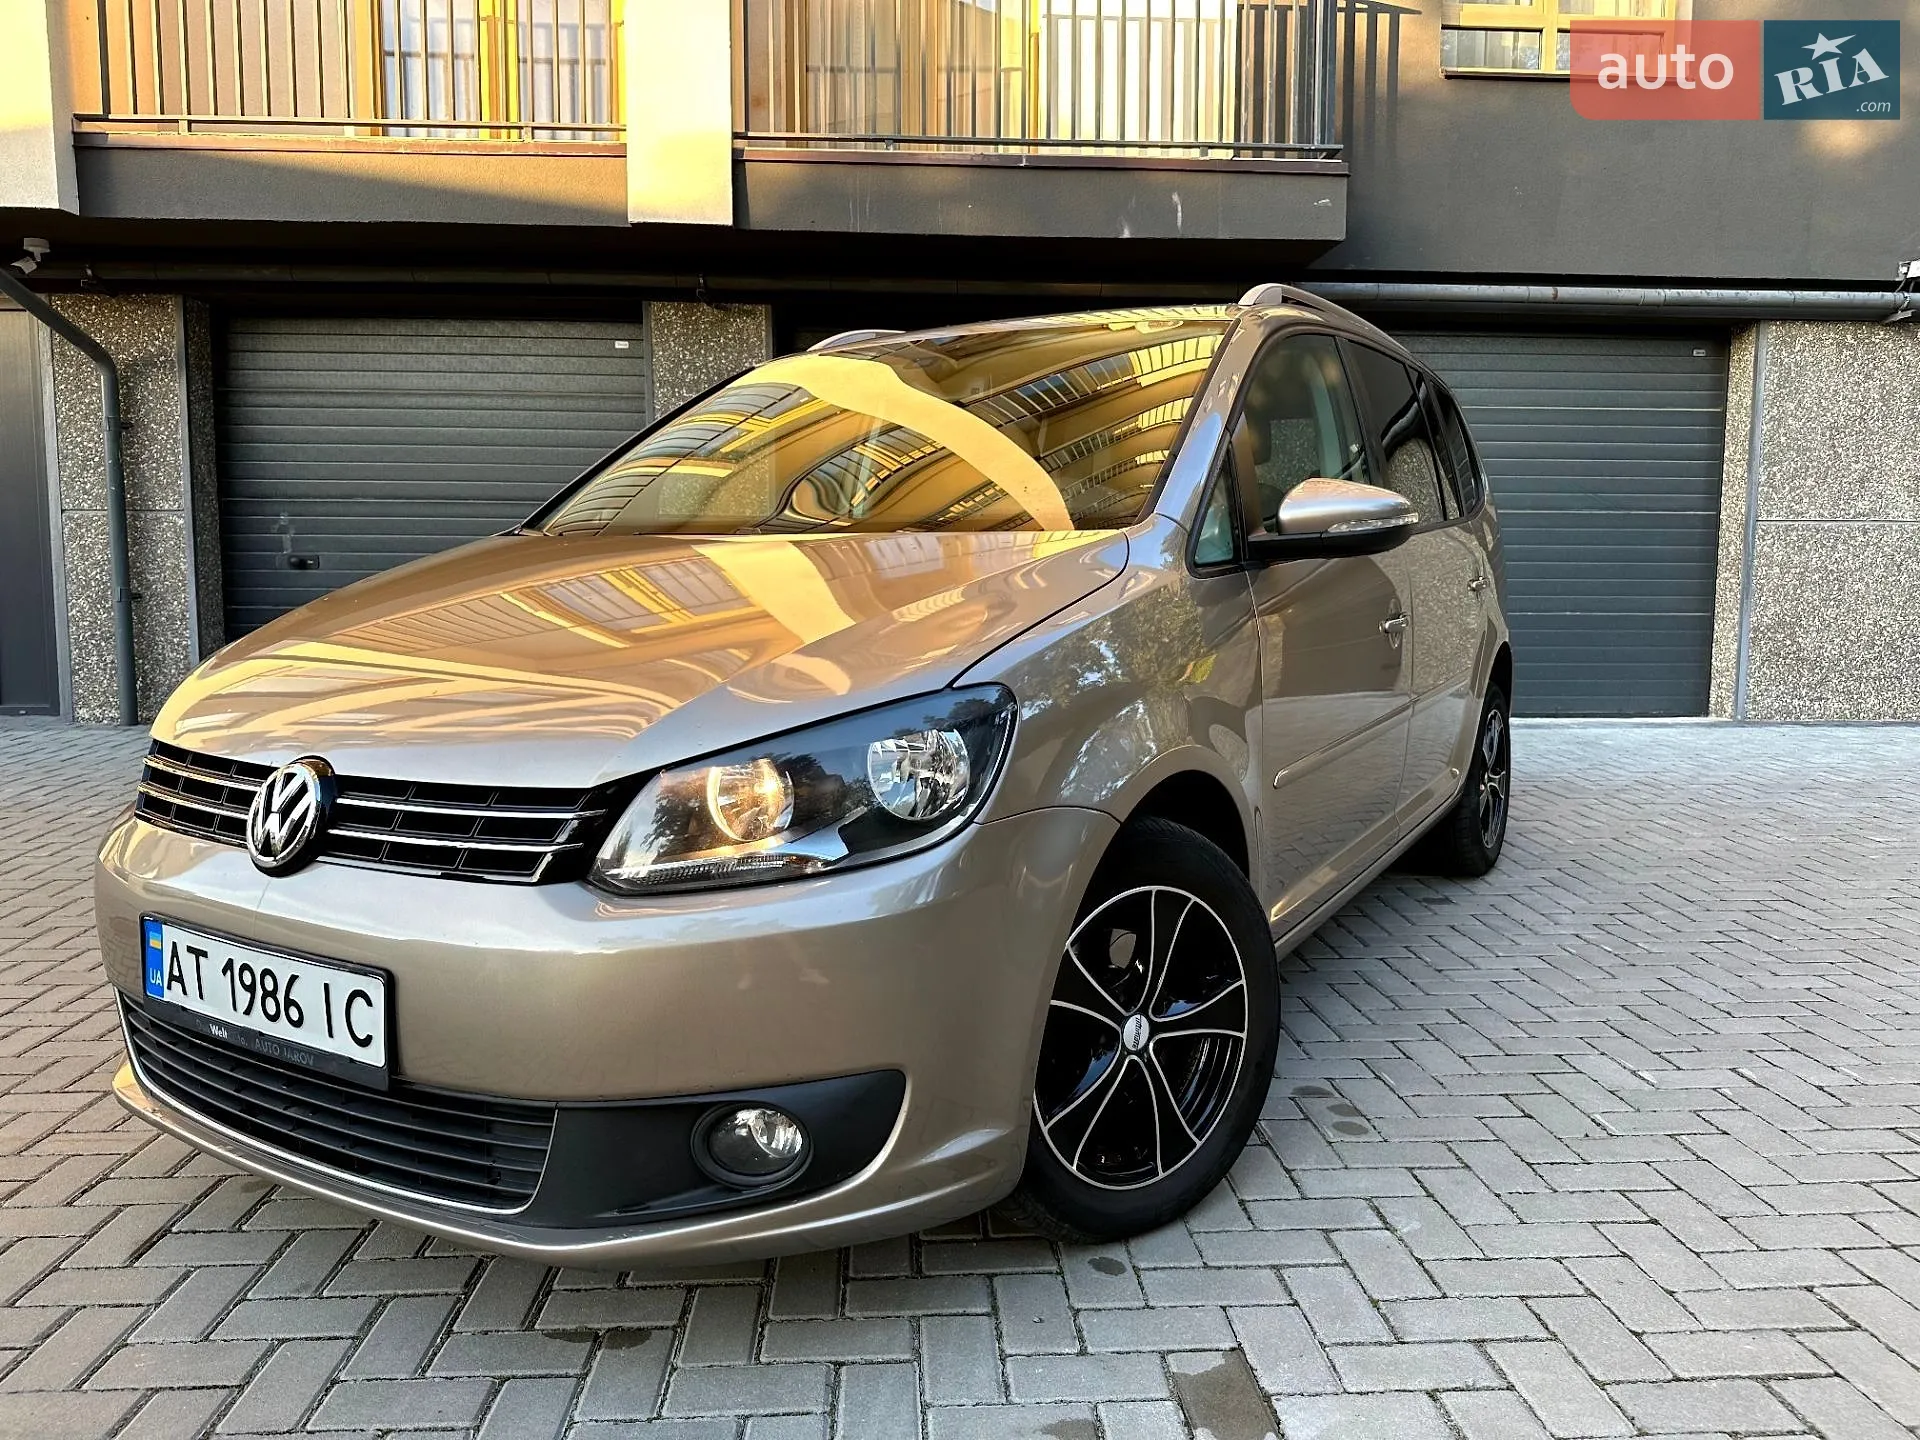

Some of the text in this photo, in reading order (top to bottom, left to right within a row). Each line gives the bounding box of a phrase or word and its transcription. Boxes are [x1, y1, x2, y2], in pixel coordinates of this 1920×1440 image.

[150, 968, 162, 988] UA
[166, 940, 374, 1048] AT 1986 IC
[255, 1038, 280, 1056] AUTO
